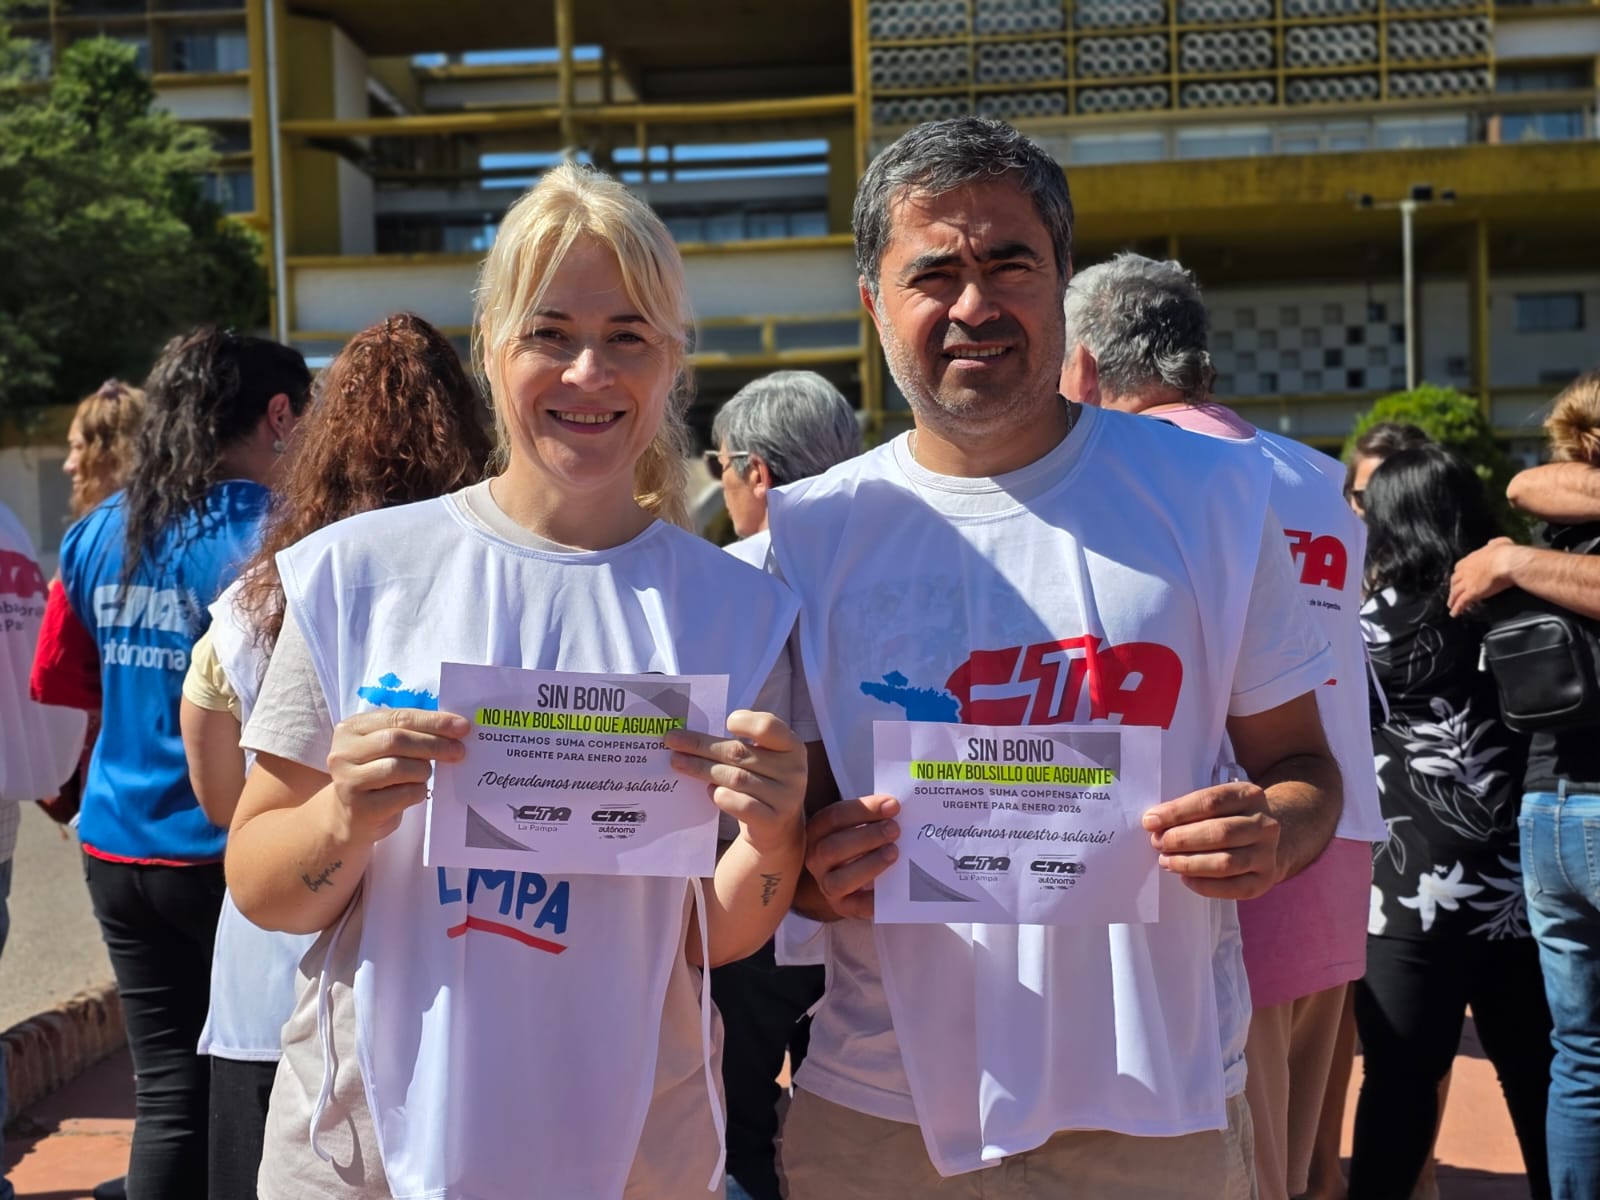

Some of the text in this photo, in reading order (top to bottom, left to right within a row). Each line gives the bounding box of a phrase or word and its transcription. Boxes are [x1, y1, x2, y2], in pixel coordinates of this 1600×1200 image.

[944, 634, 1183, 730] CTA
[537, 683, 626, 713] SIN BONO
[482, 708, 501, 725] NO
[503, 709, 530, 728] HAY
[532, 712, 592, 731] BOLSILLO
[594, 715, 619, 733] QUE
[478, 732, 671, 751] SOLICITAMOS SUMA COMPENSATOR
[506, 748, 648, 764] URGENTE PARA ENERO 2026
[967, 737, 1054, 763] SIN BONO
[477, 771, 679, 793] ¡Defendamos nuestro salario!
[917, 763, 1113, 785] NO HAY BOLSILLO QUE AGUANTE
[914, 786, 1111, 801] SOLICITAMOS SUMA COMPENSATORIA
[517, 805, 572, 821] CTA
[942, 800, 1082, 814] URGENTE PARA ENERO 2026
[591, 810, 639, 822] CTA
[518, 823, 528, 831] La
[529, 825, 558, 833] Pampa
[598, 825, 636, 834] autónoma
[917, 824, 1115, 844] ¡Defendamos nuestro salario!
[958, 855, 1011, 871] CTA
[1030, 860, 1078, 874] CTA
[970, 874, 998, 882] Pampa
[1038, 877, 1077, 885] autónoma
